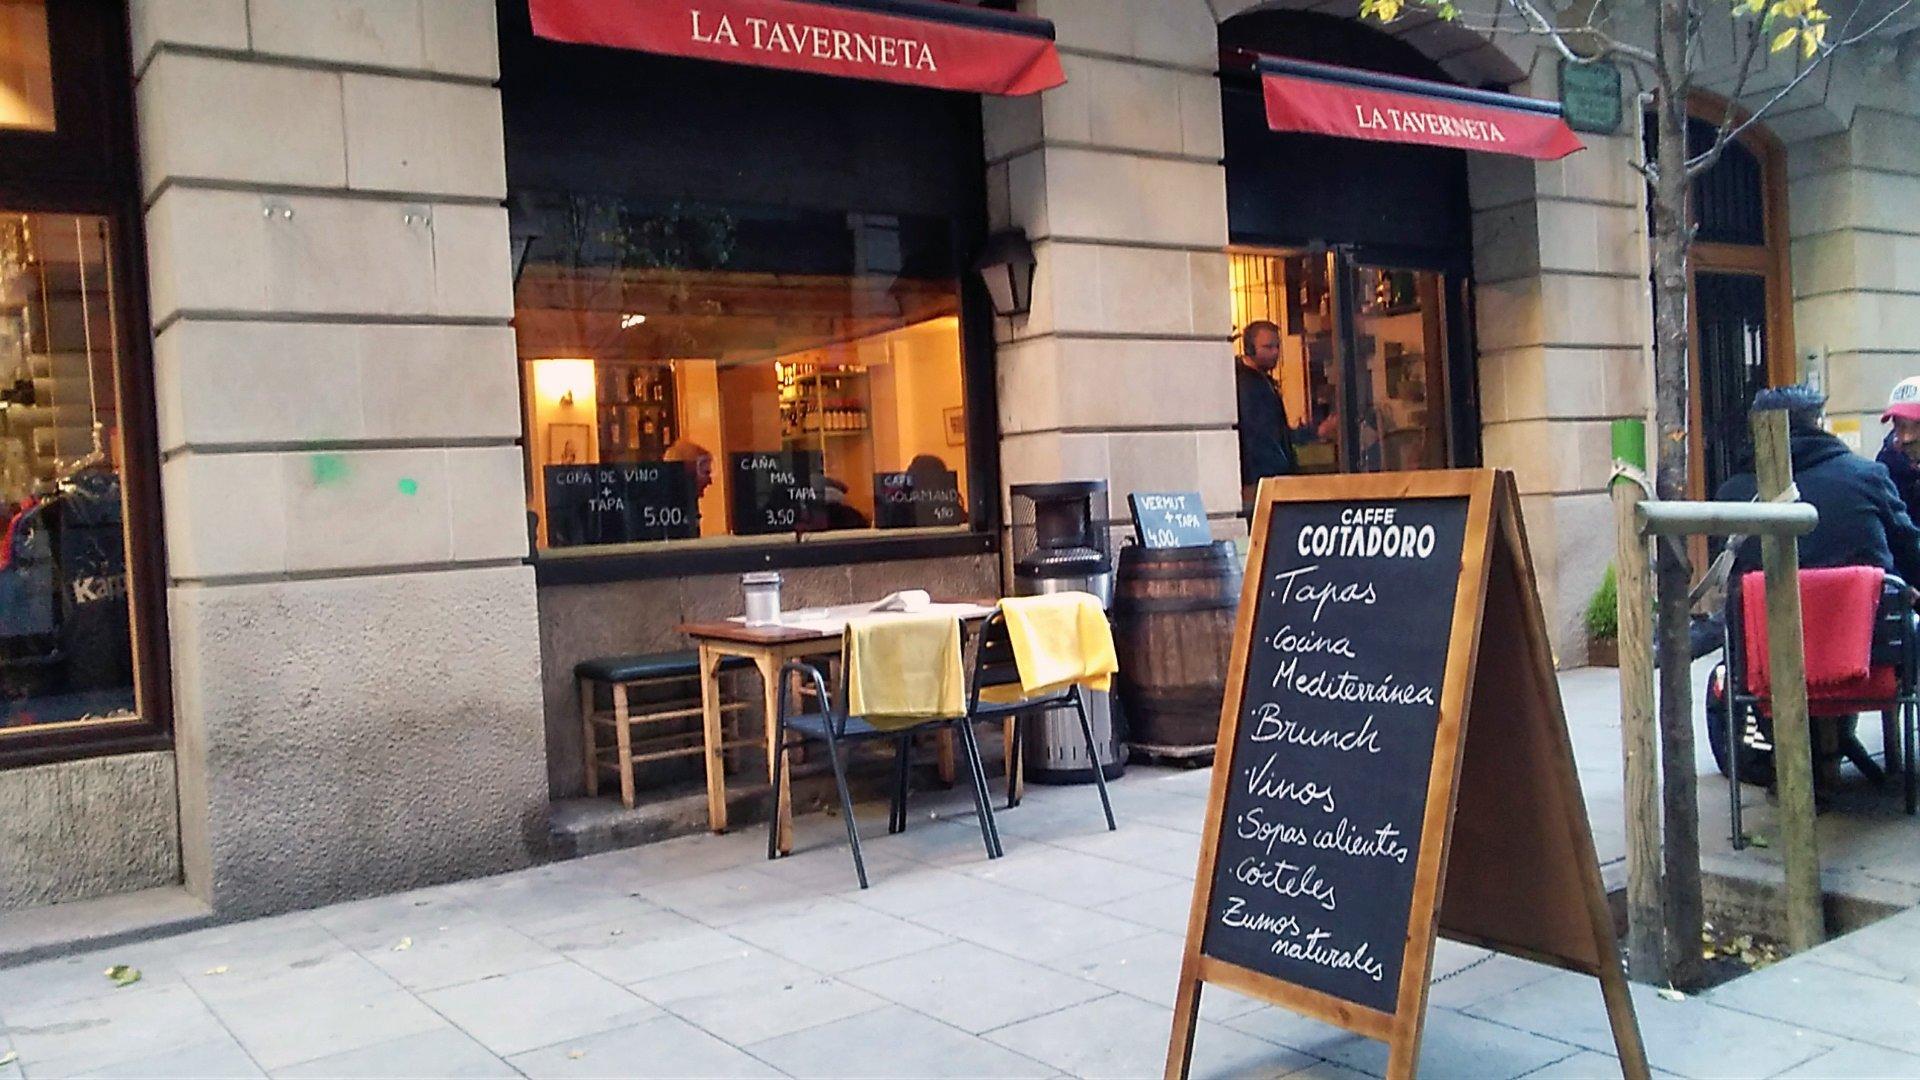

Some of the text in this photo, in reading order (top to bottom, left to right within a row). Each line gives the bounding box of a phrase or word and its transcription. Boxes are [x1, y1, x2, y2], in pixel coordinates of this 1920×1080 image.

[691, 10, 937, 71] LA TAVERNETA
[1355, 104, 1505, 142] LA TAVERNETA
[556, 469, 658, 485] COPA DE VINO
[740, 455, 777, 470] CAÑA
[770, 472, 795, 485] MAS
[588, 498, 624, 512] TAPA
[601, 487, 612, 497] +
[787, 487, 816, 500] TAPA
[1141, 496, 1185, 511] VERMUT
[1164, 511, 1200, 528] + TAPA
[1298, 525, 1436, 558] COSTADORO
[1275, 565, 1377, 622] Tapas
[1273, 625, 1355, 658] Cocina
[1272, 656, 1435, 706] Mediterránea
[1251, 702, 1381, 753] Brunch
[1248, 752, 1335, 813] Vinos
[1237, 807, 1409, 864] Sopas calientes
[1236, 856, 1336, 911] Cócteles
[1222, 897, 1301, 937] Zumos
[1271, 927, 1384, 982] naturales
